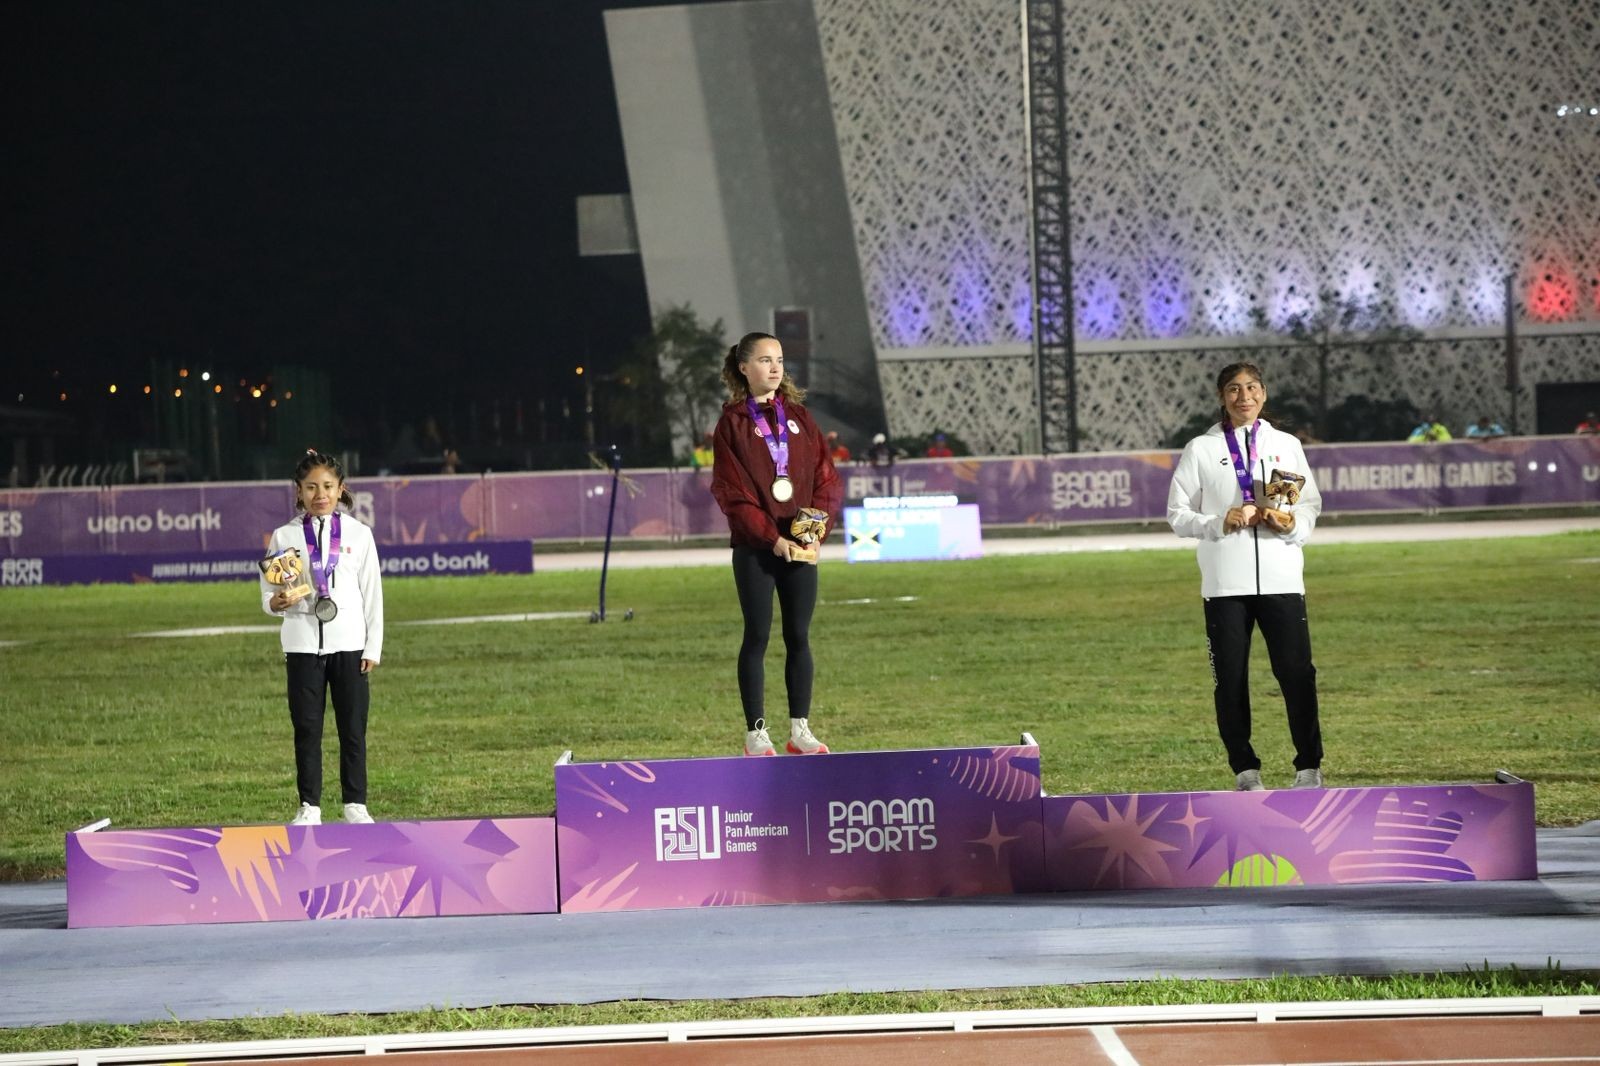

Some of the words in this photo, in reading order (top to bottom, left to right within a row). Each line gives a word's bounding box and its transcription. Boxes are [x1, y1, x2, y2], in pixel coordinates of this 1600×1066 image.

[1052, 470, 1131, 493] PANAM
[1336, 462, 1441, 490] AMERICAN
[1444, 461, 1517, 488] GAMES
[1052, 490, 1133, 510] SPORTS
[88, 514, 152, 533] ueno
[157, 508, 221, 531] bank
[152, 563, 188, 577] JUNIOR
[189, 562, 209, 576] PAN
[433, 551, 490, 571] bank
[725, 810, 753, 824] Junior
[828, 797, 935, 828] PANAM
[725, 826, 743, 838] Pan
[744, 824, 789, 837] American
[828, 825, 938, 854] SPORTS
[726, 841, 757, 853] Games
